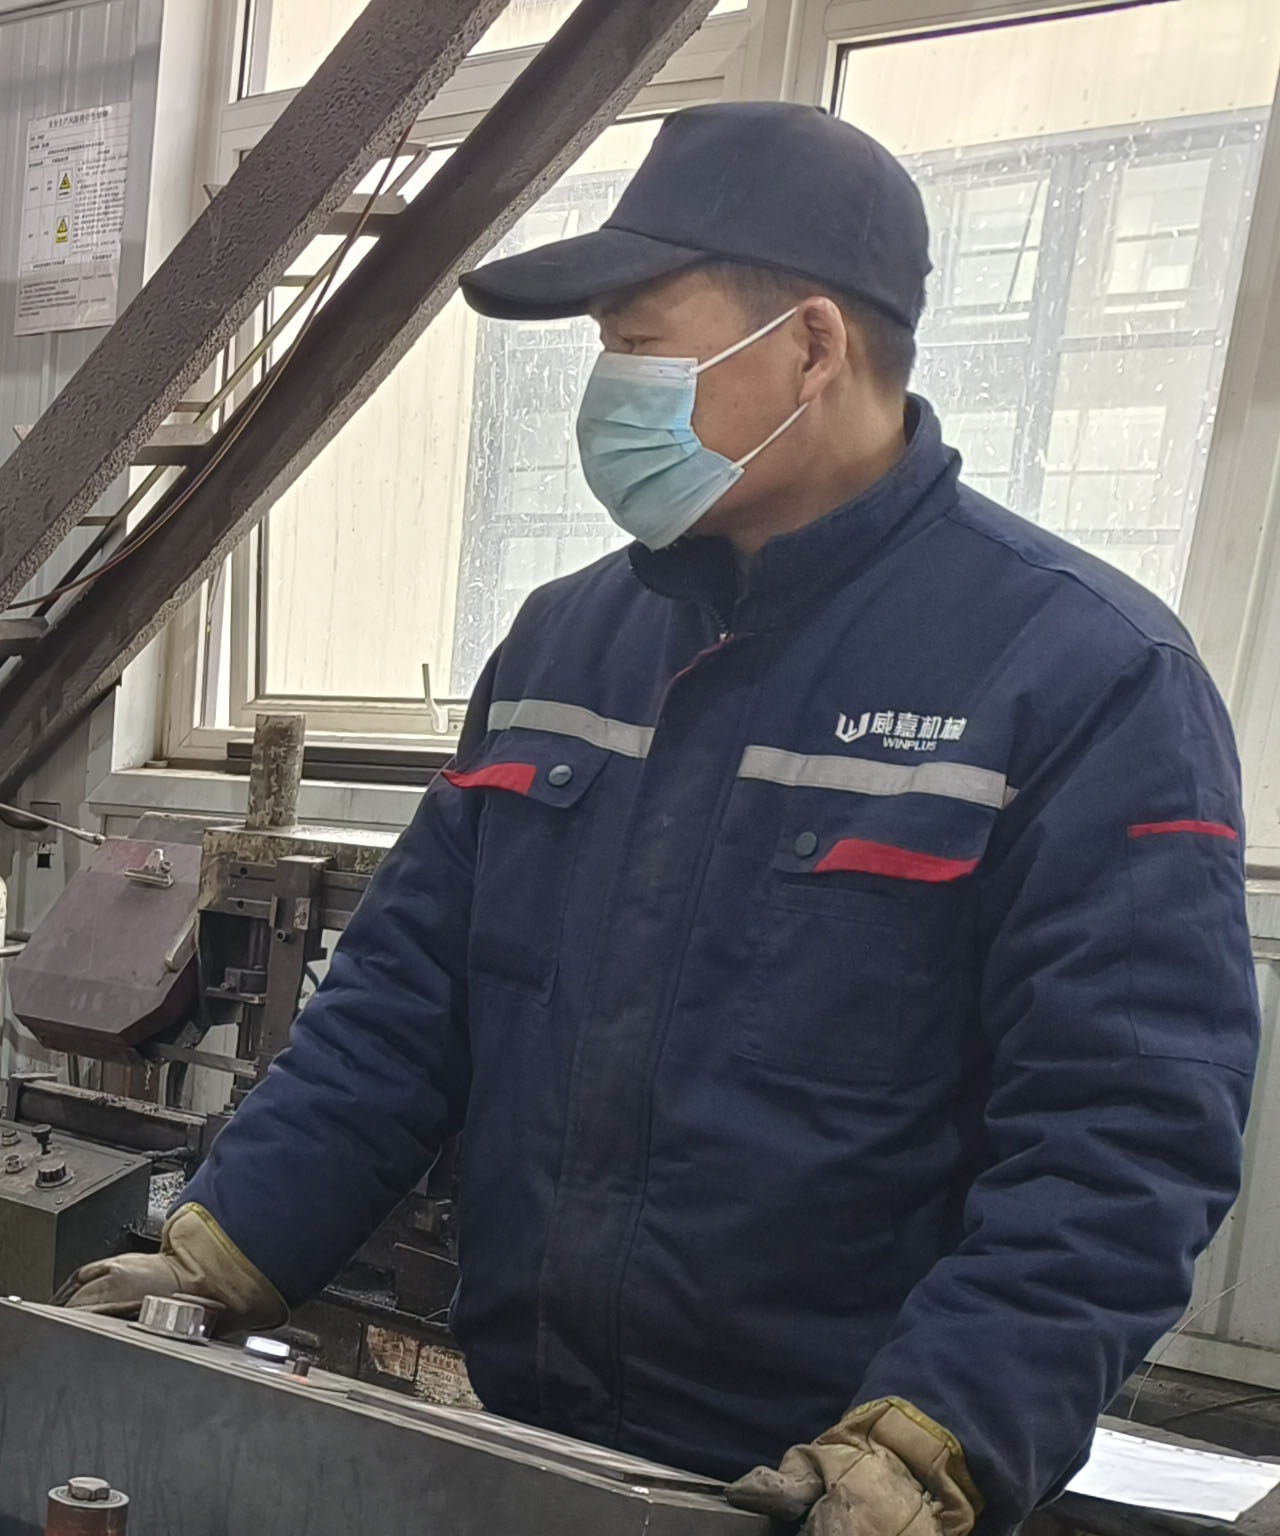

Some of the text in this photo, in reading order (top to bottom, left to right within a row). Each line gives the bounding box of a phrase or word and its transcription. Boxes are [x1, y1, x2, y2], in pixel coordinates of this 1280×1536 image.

[870, 710, 967, 740] 威嘉机械
[883, 736, 938, 751] WINPLUS
